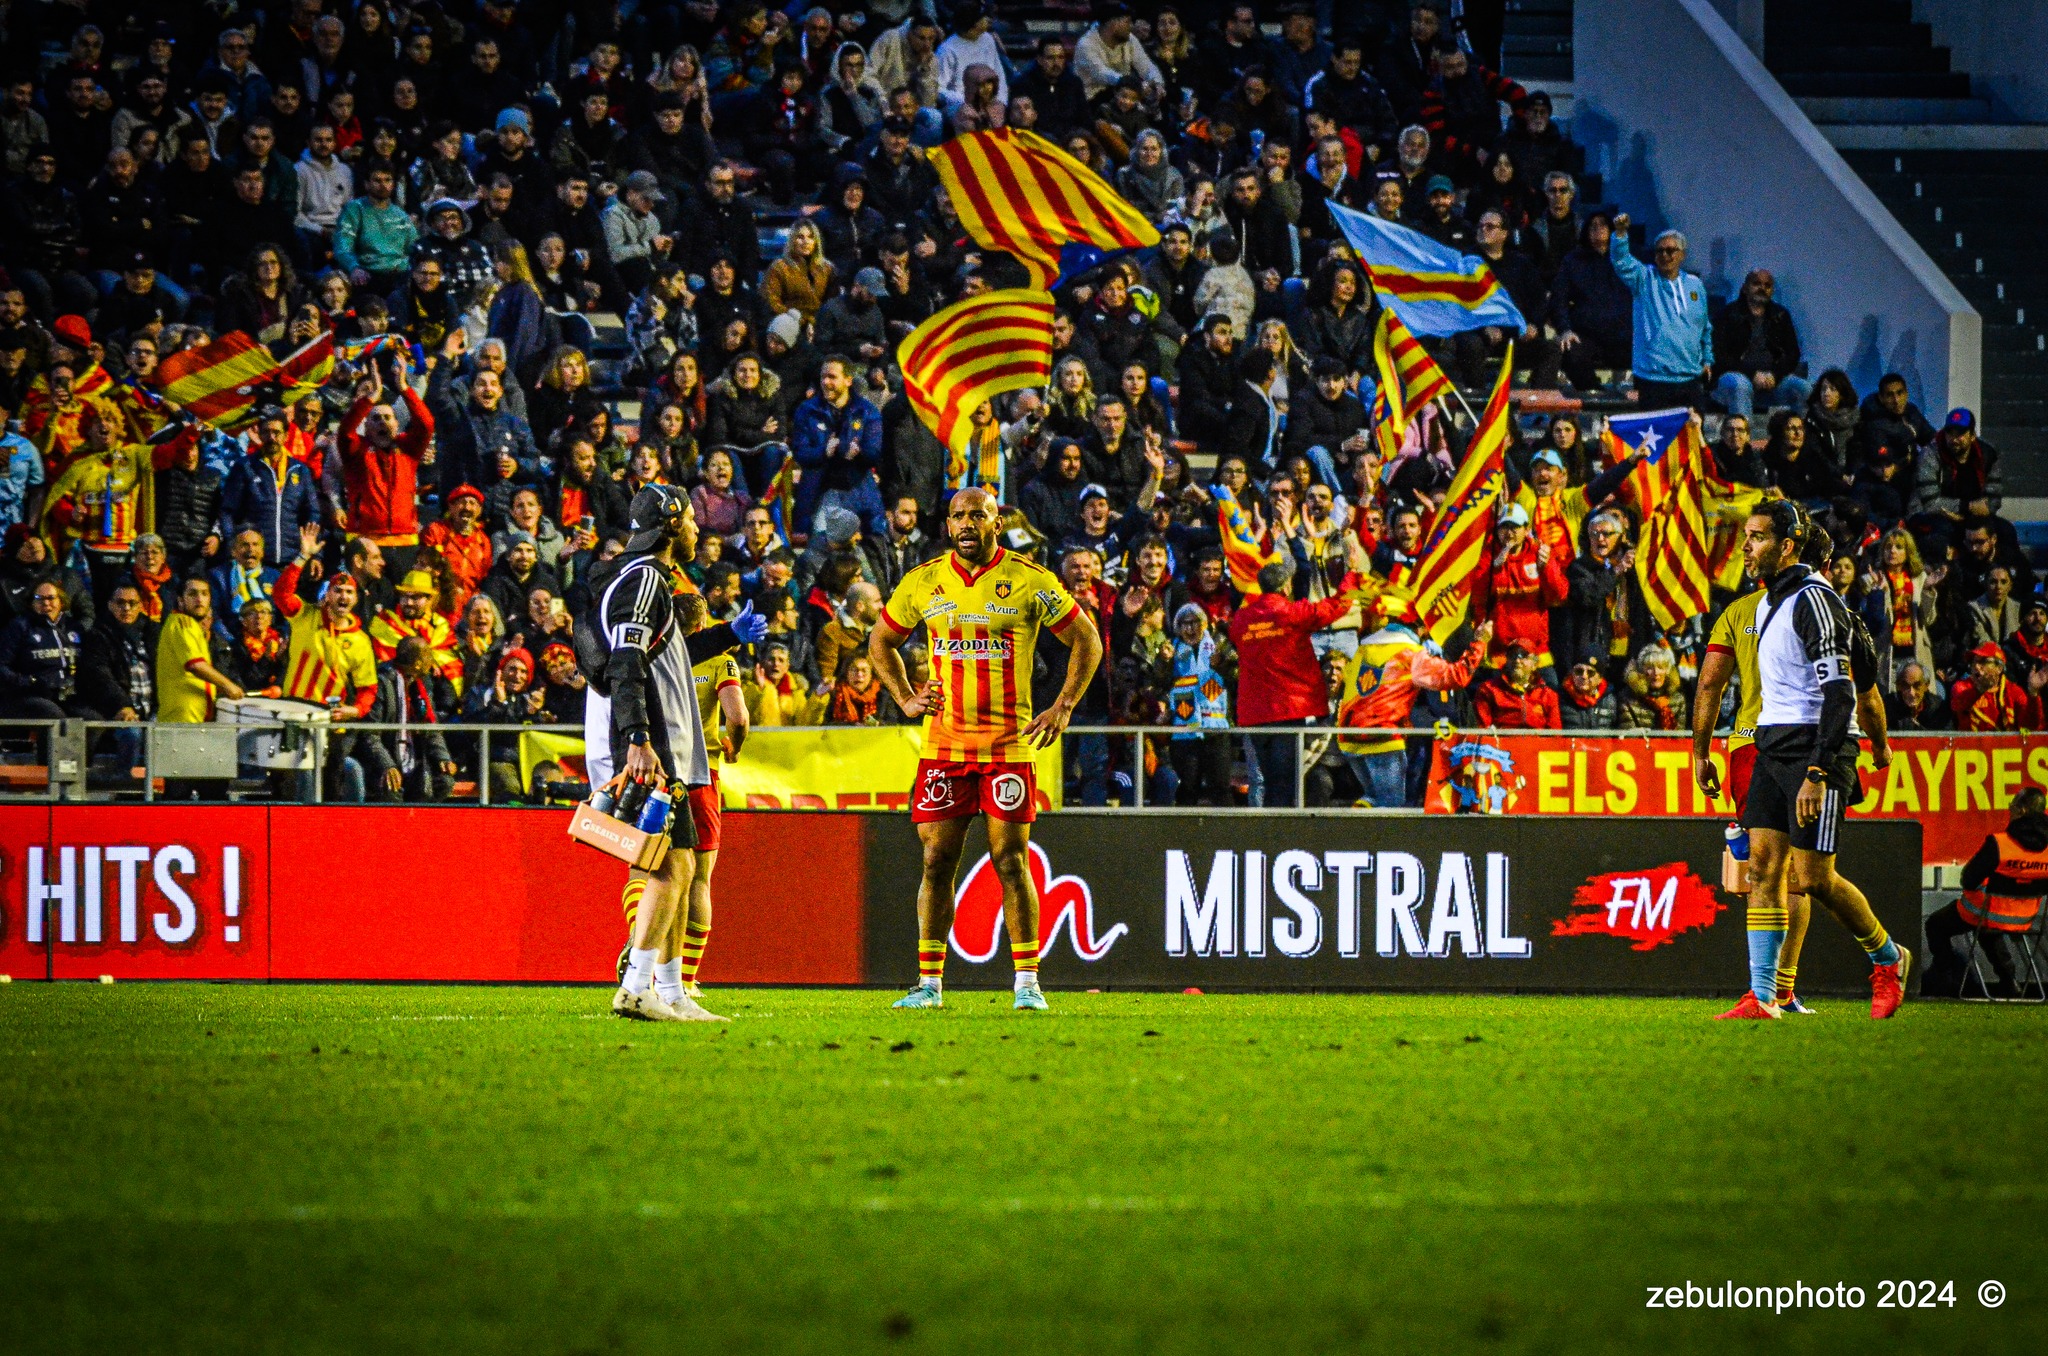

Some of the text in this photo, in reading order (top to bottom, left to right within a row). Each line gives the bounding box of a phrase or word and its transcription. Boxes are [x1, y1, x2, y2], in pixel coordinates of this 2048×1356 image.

[947, 639, 1012, 651] ZODIAC
[1816, 662, 1829, 681] S
[926, 769, 945, 779] CFA
[1537, 750, 1638, 815] ELS
[27, 845, 197, 943] HITS
[1165, 849, 1532, 958] MISTRAL
[1604, 875, 1679, 932] FM
